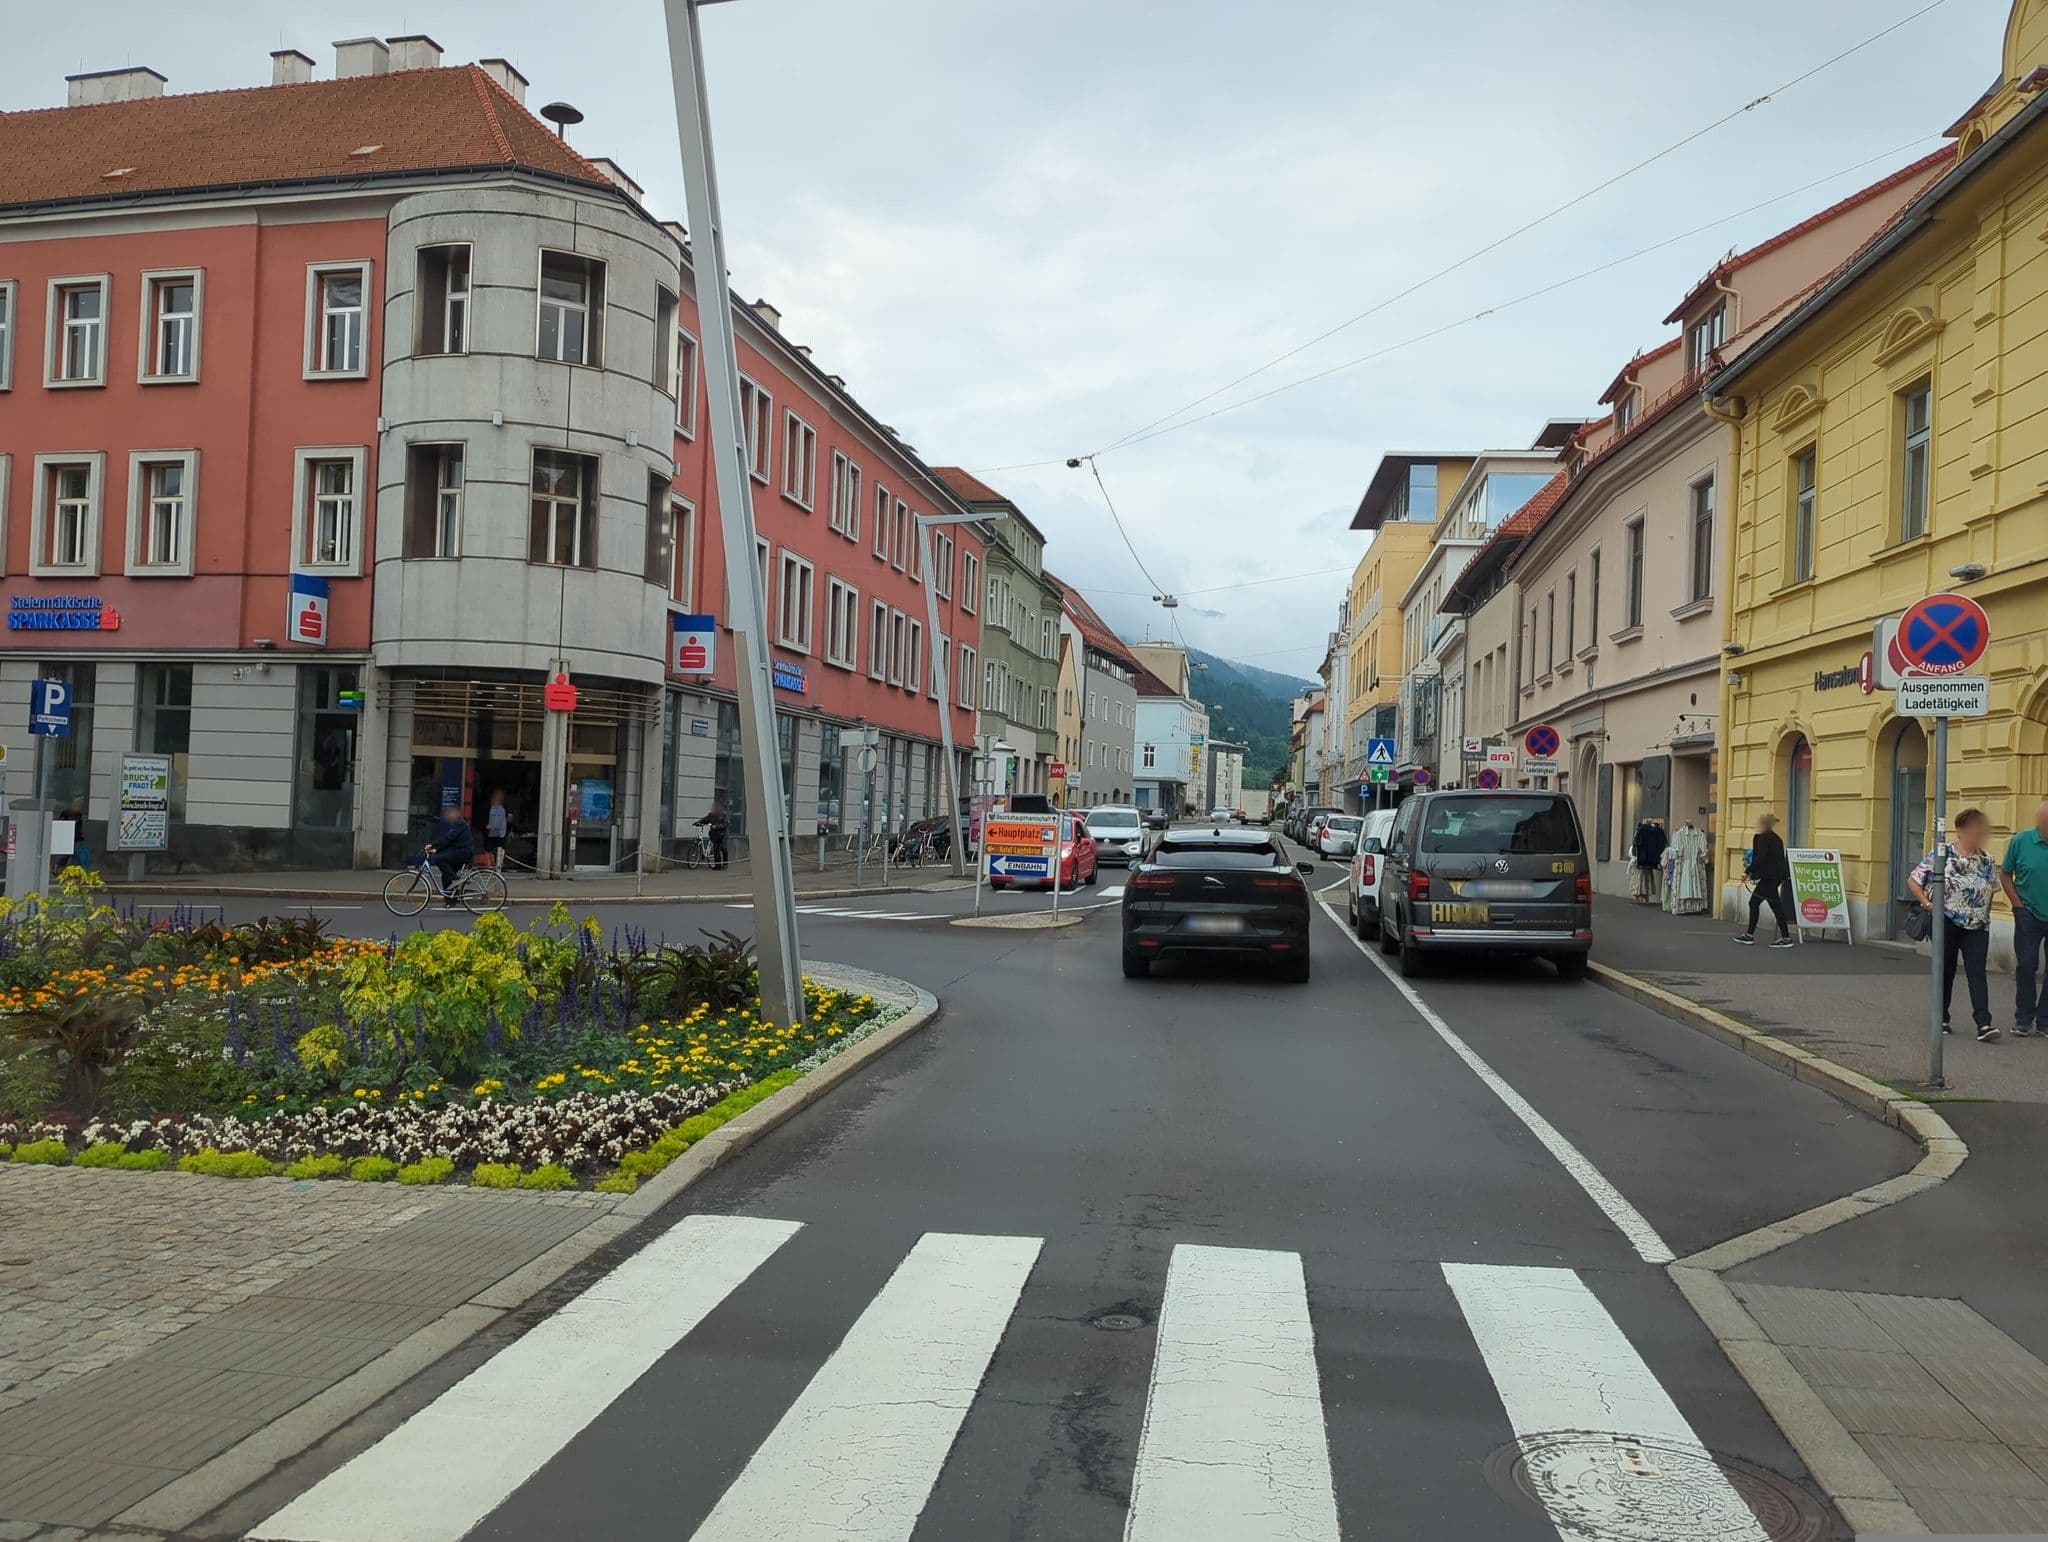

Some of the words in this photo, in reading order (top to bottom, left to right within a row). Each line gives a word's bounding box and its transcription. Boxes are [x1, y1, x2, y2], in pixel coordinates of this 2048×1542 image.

[10, 595, 102, 609] Steiermärkische
[8, 611, 100, 630] SPARKASSE
[1918, 660, 1966, 674] ANFANG
[1814, 665, 1859, 692] Hansaton
[1901, 681, 1985, 695] Ausgenommen
[1905, 697, 1979, 711] Ladetätigkeit
[1490, 753, 1510, 761] ara
[123, 774, 150, 782] BRUCK
[999, 827, 1040, 840] Hauptplatz
[1797, 852, 1824, 860] Hansaton
[1008, 862, 1042, 870] EINBAHN
[1812, 868, 1837, 882] gut
[1797, 879, 1840, 892] hören
[1823, 893, 1841, 902] Sie?
